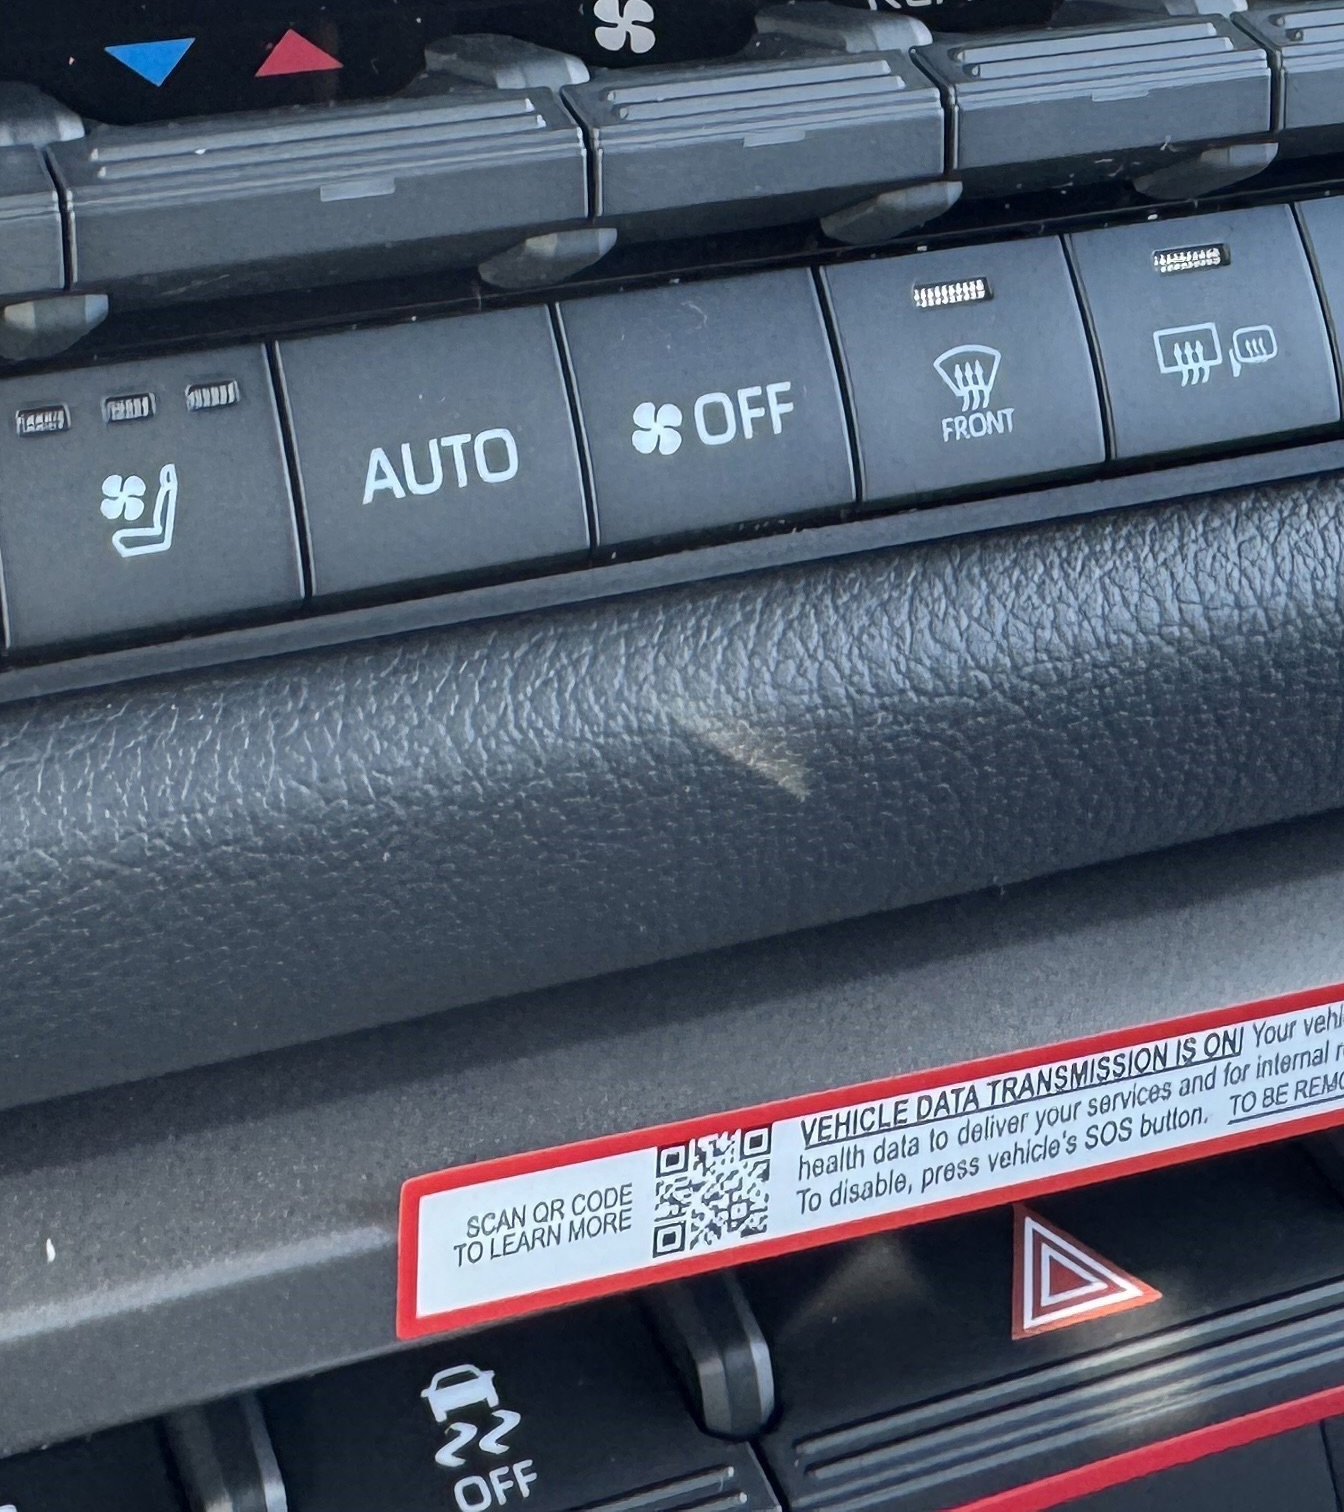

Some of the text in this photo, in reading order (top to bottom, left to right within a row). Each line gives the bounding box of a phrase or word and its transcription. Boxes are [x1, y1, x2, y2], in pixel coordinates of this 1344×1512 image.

[695, 382, 794, 446] OFF
[942, 407, 1015, 442] FRONT
[363, 429, 519, 504] AUTO
[798, 1143, 865, 1182] health
[873, 1134, 920, 1165] data
[929, 1128, 949, 1153] to
[957, 1112, 1030, 1146] deliver
[1034, 1100, 1082, 1136] your
[1087, 1081, 1172, 1118] services
[1178, 1065, 1217, 1097] and
[1223, 1061, 1251, 1087] for
[1256, 1039, 1330, 1079] internal
[800, 1098, 909, 1148] VEHICLE
[913, 1084, 980, 1124] DATA
[986, 1042, 1168, 1106] TRANSMISSION
[1175, 1036, 1197, 1066] IS
[1252, 1019, 1297, 1048] Your
[1229, 1090, 1257, 1116] TO
[1262, 1082, 1289, 1109] BE
[796, 1106, 1208, 1215] To disable, press vehicle's SOS button.
[453, 1207, 633, 1268] TO LEARN MORE
[466, 1182, 633, 1239] SCAN QR CODE
[453, 1459, 537, 1512] OFF
